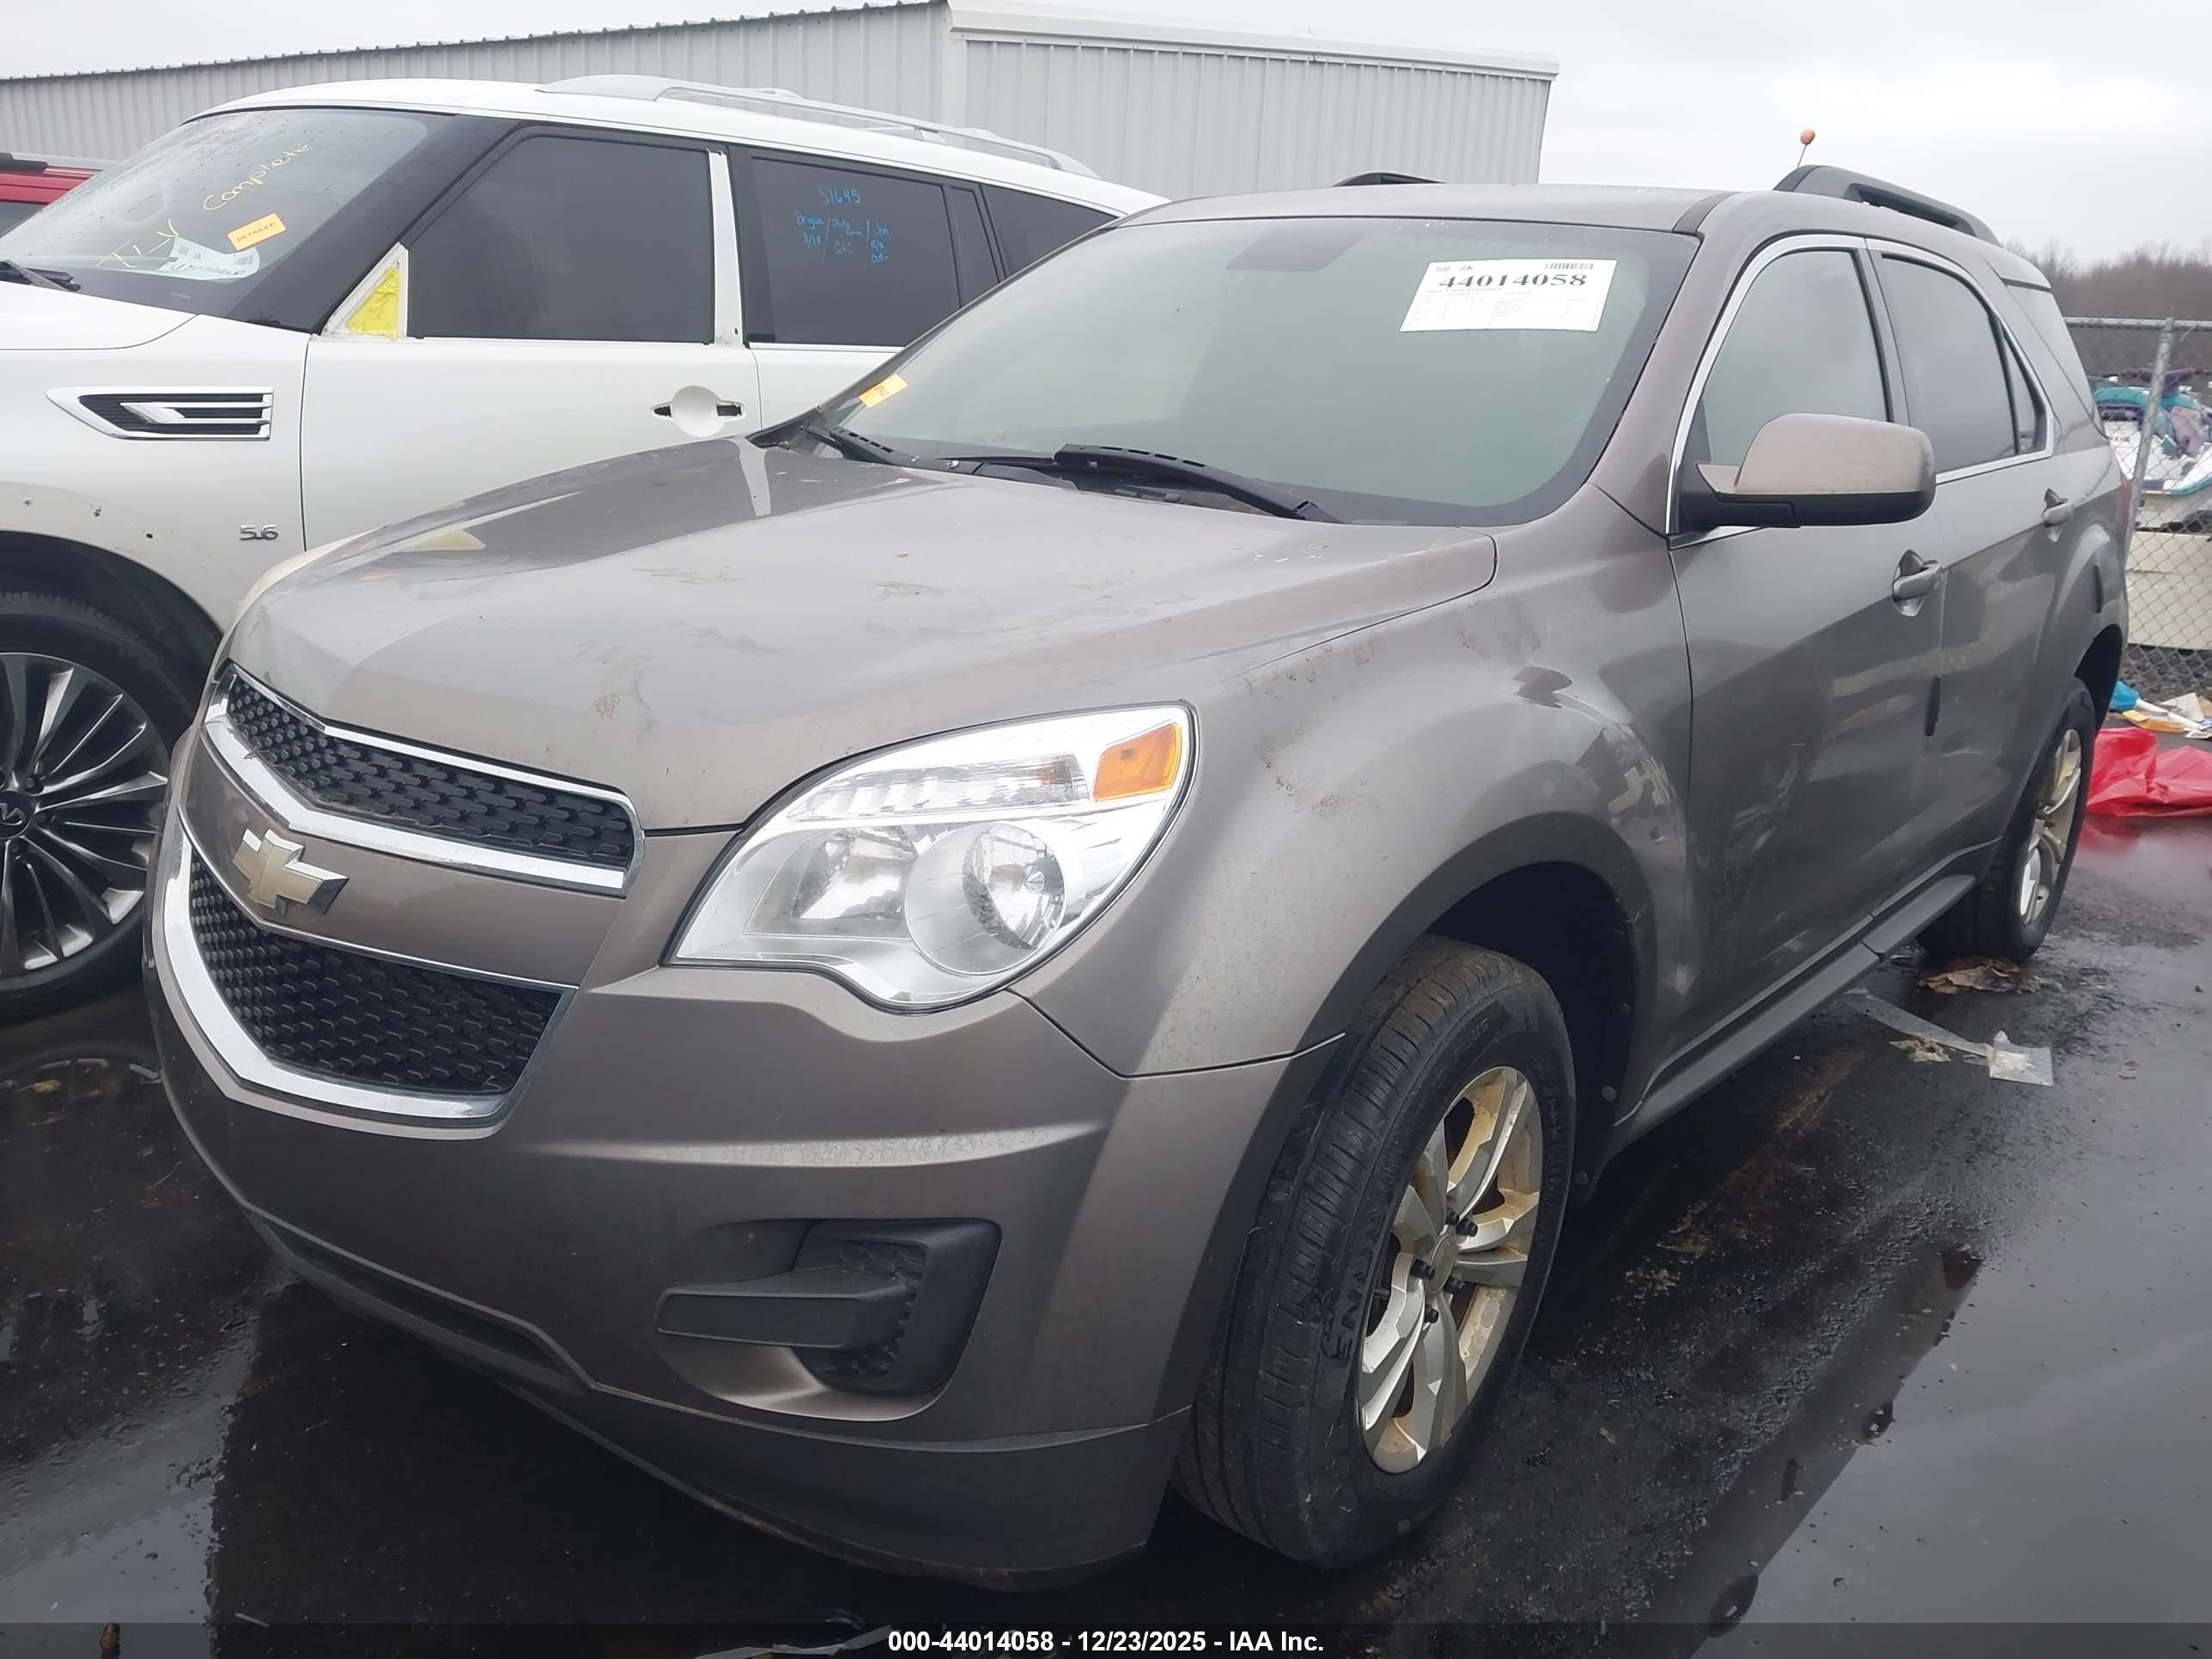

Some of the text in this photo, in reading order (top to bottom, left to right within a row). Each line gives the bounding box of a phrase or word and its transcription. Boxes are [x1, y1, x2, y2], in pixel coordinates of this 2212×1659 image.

[204, 144, 310, 210] Complete
[817, 186, 861, 204] 51645
[1439, 273, 1587, 288] 44014058
[240, 524, 279, 541] 5.6
